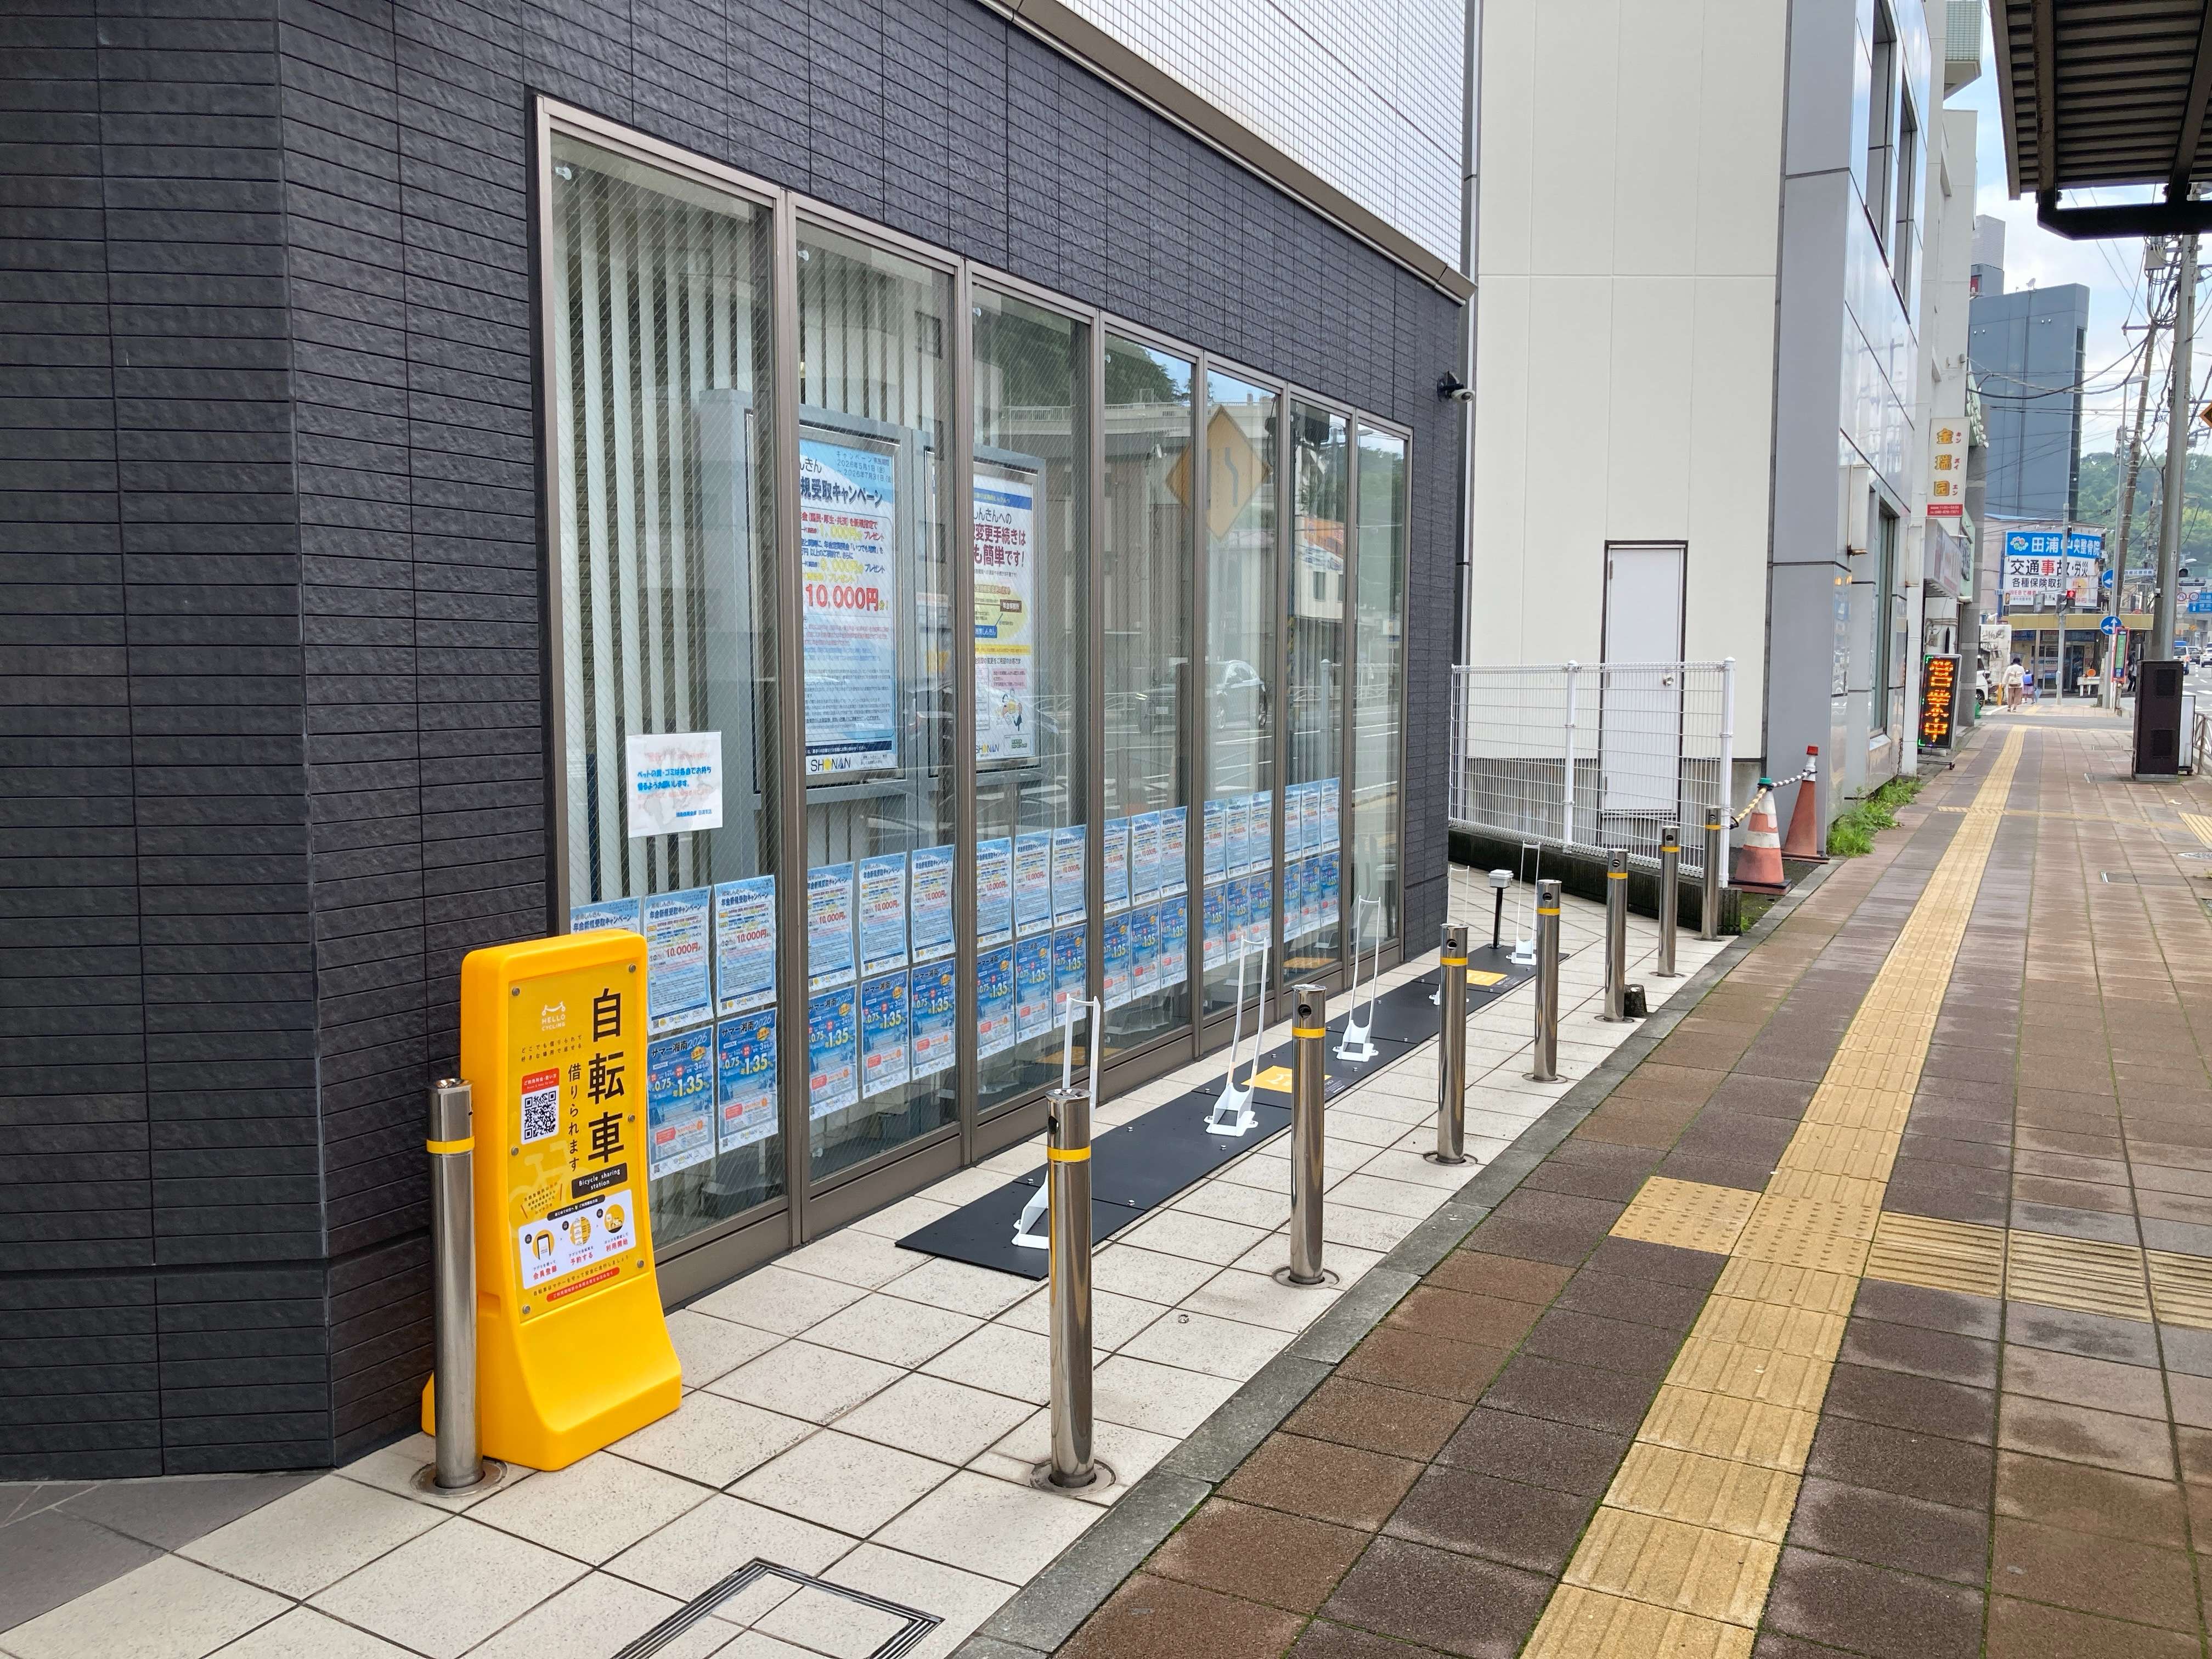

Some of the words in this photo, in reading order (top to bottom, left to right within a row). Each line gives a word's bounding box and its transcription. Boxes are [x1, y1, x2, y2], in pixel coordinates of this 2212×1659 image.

[974, 523, 1026, 546] 変更手続きは
[1925, 661, 1954, 743] 営業中
[811, 757, 851, 772] SHONAN
[721, 893, 768, 906] 年金新規受取キャンペーン
[650, 904, 702, 919] 年金新規受取キャンペーン
[573, 915, 631, 932] 年金新規受取キャンペーン
[542, 1014, 566, 1024] HELLO
[542, 1022, 566, 1031] CYCLING
[522, 1035, 582, 1053] どこでも借りられて
[588, 988, 625, 1163] 自転車
[568, 1063, 581, 1171] 借りられます
[579, 1175, 599, 1187] Bicycle
[601, 1168, 620, 1180] sharing
[590, 1180, 610, 1190] station
[606, 1239, 628, 1252] 利用開始
[570, 1252, 593, 1266] 予約する
[533, 1265, 557, 1280] 会員登録
